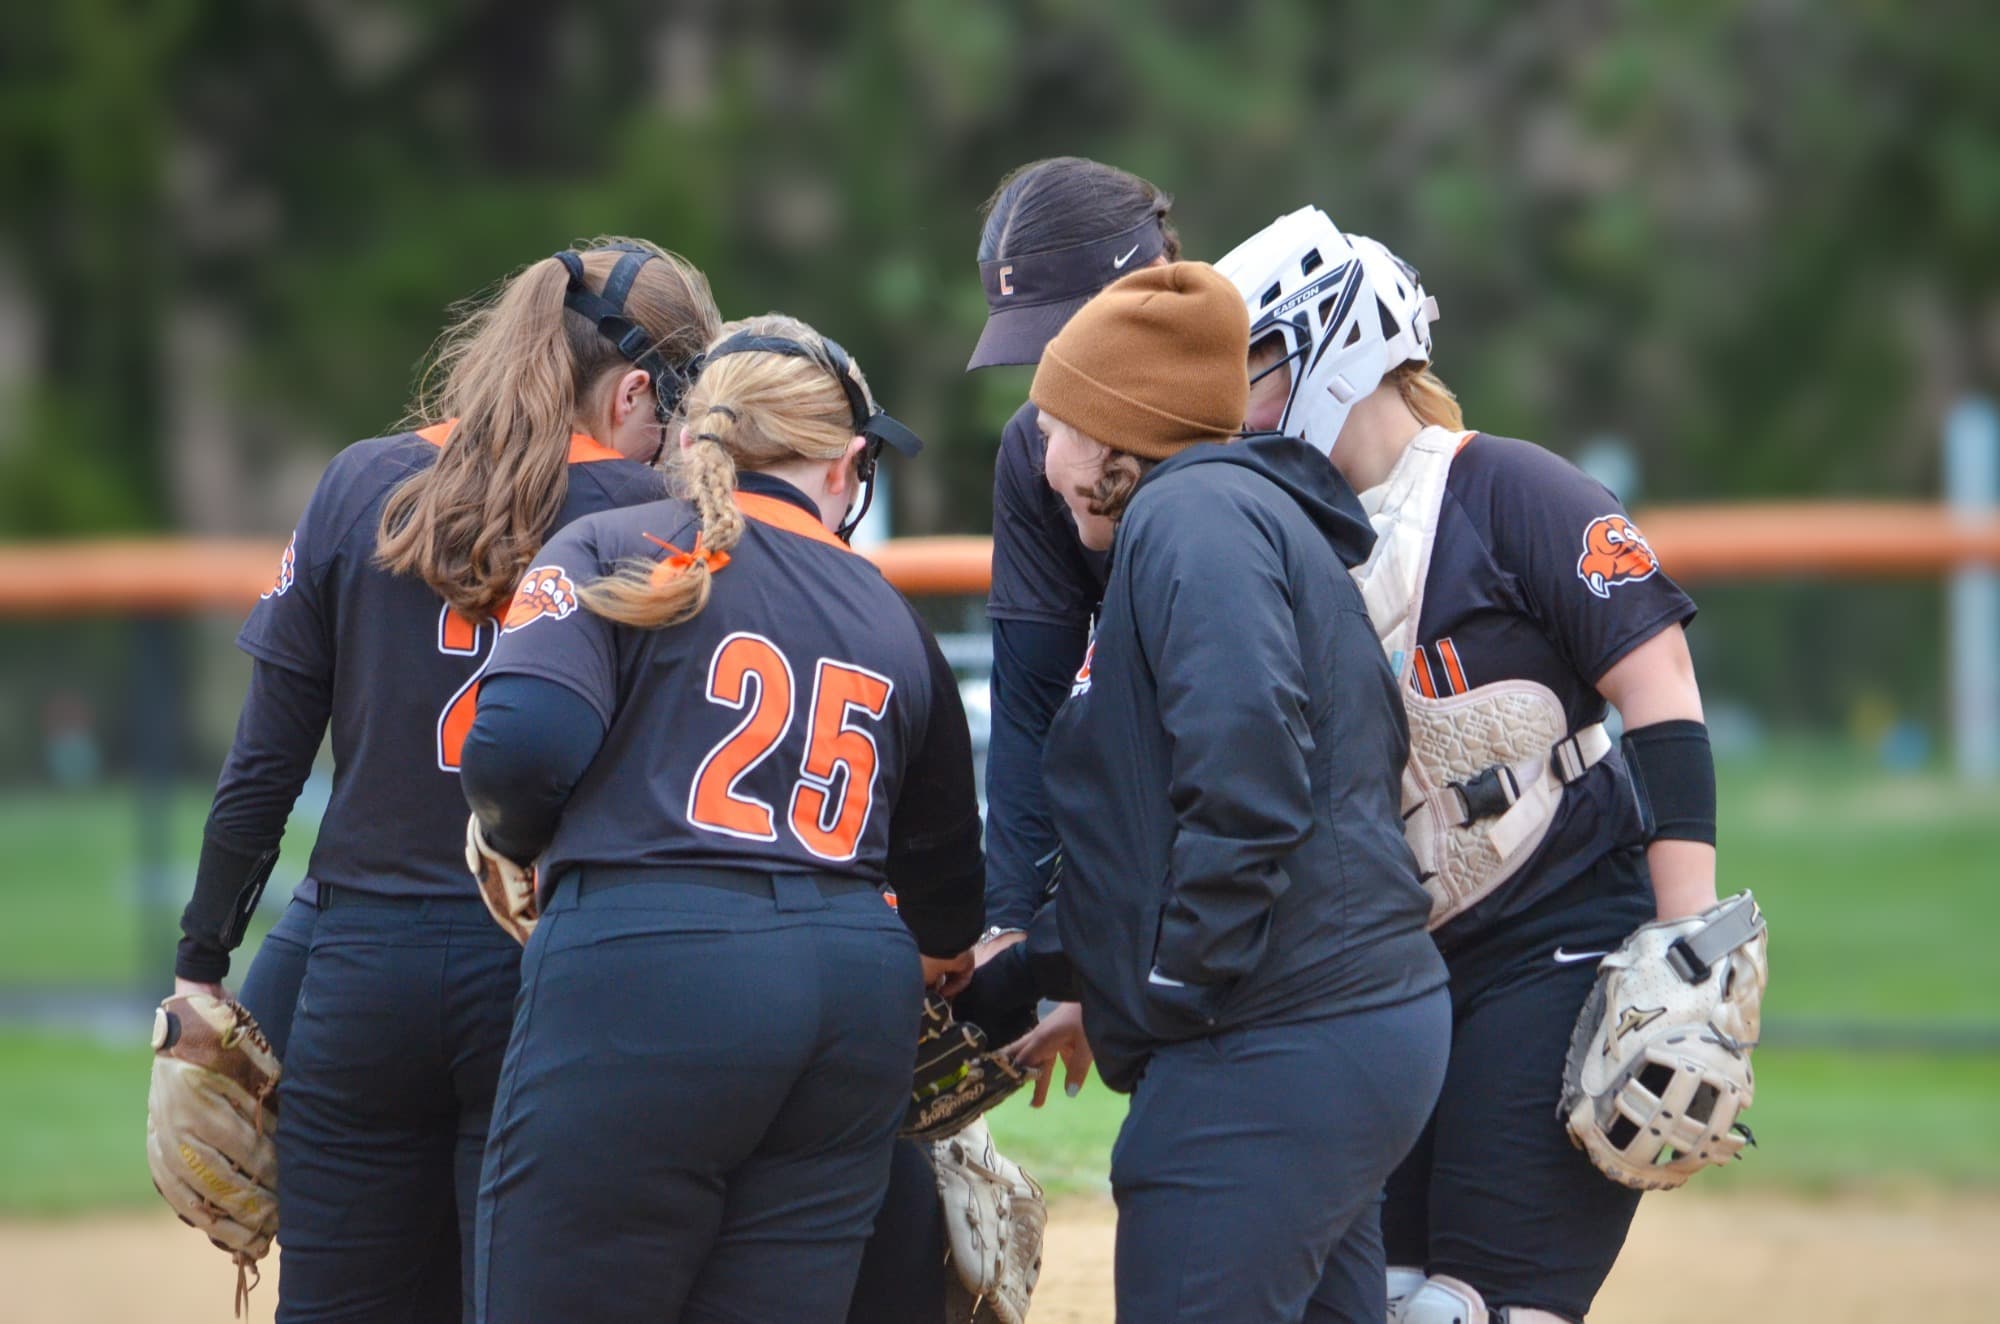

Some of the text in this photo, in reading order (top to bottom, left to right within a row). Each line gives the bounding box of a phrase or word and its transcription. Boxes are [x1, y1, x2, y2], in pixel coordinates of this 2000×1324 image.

[999, 265, 1014, 296] C
[1273, 285, 1319, 317] EASTON
[687, 631, 893, 861] 25
